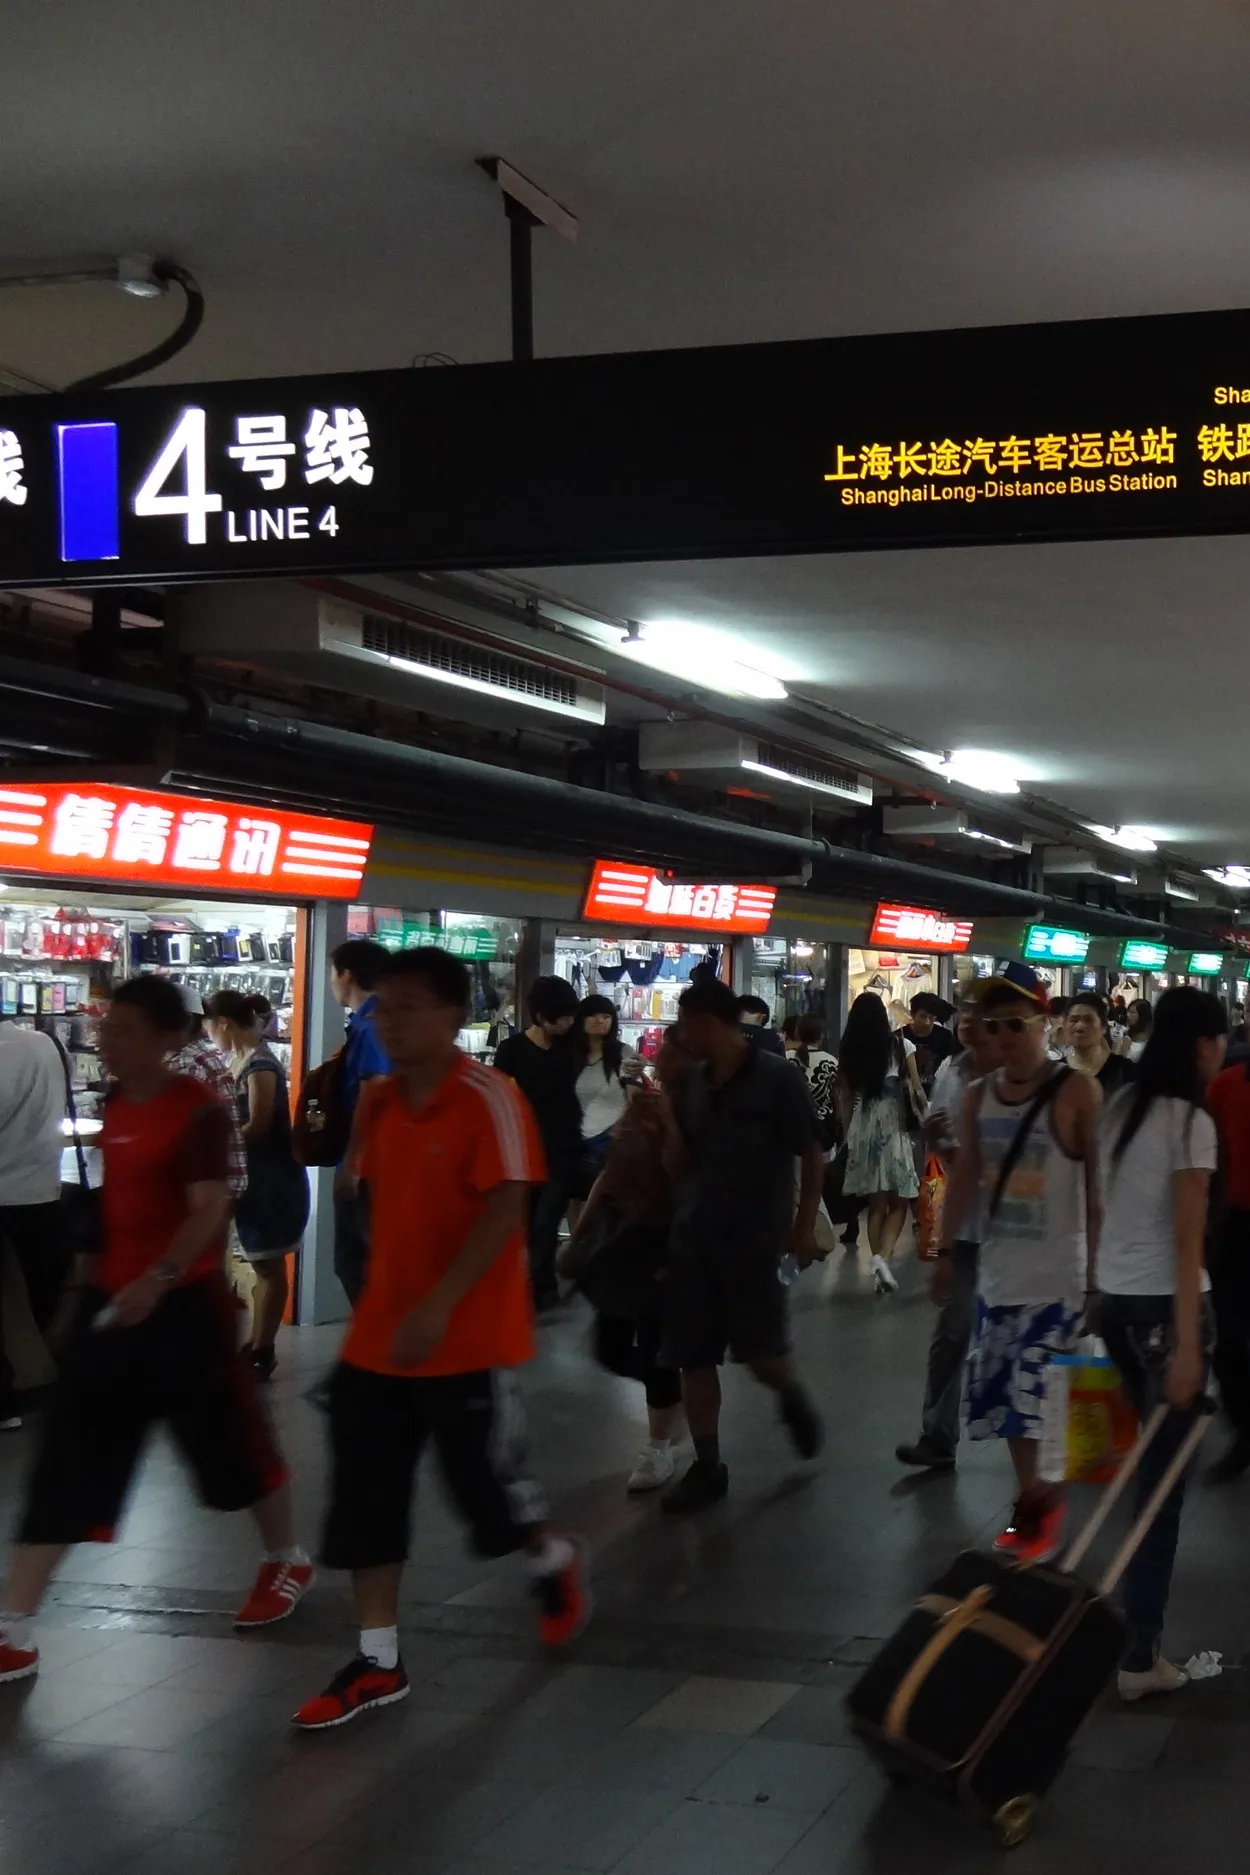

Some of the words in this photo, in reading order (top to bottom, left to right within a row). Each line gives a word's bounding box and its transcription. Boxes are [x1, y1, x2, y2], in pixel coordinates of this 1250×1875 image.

[824, 426, 1177, 480] 上海长途汽车客运总站
[842, 485, 927, 506] Shanghai
[931, 481, 1066, 502] Long-Distance
[1071, 477, 1106, 493] Bus
[1109, 473, 1176, 491] Station
[228, 507, 310, 542] LINE
[319, 506, 339, 536] 4
